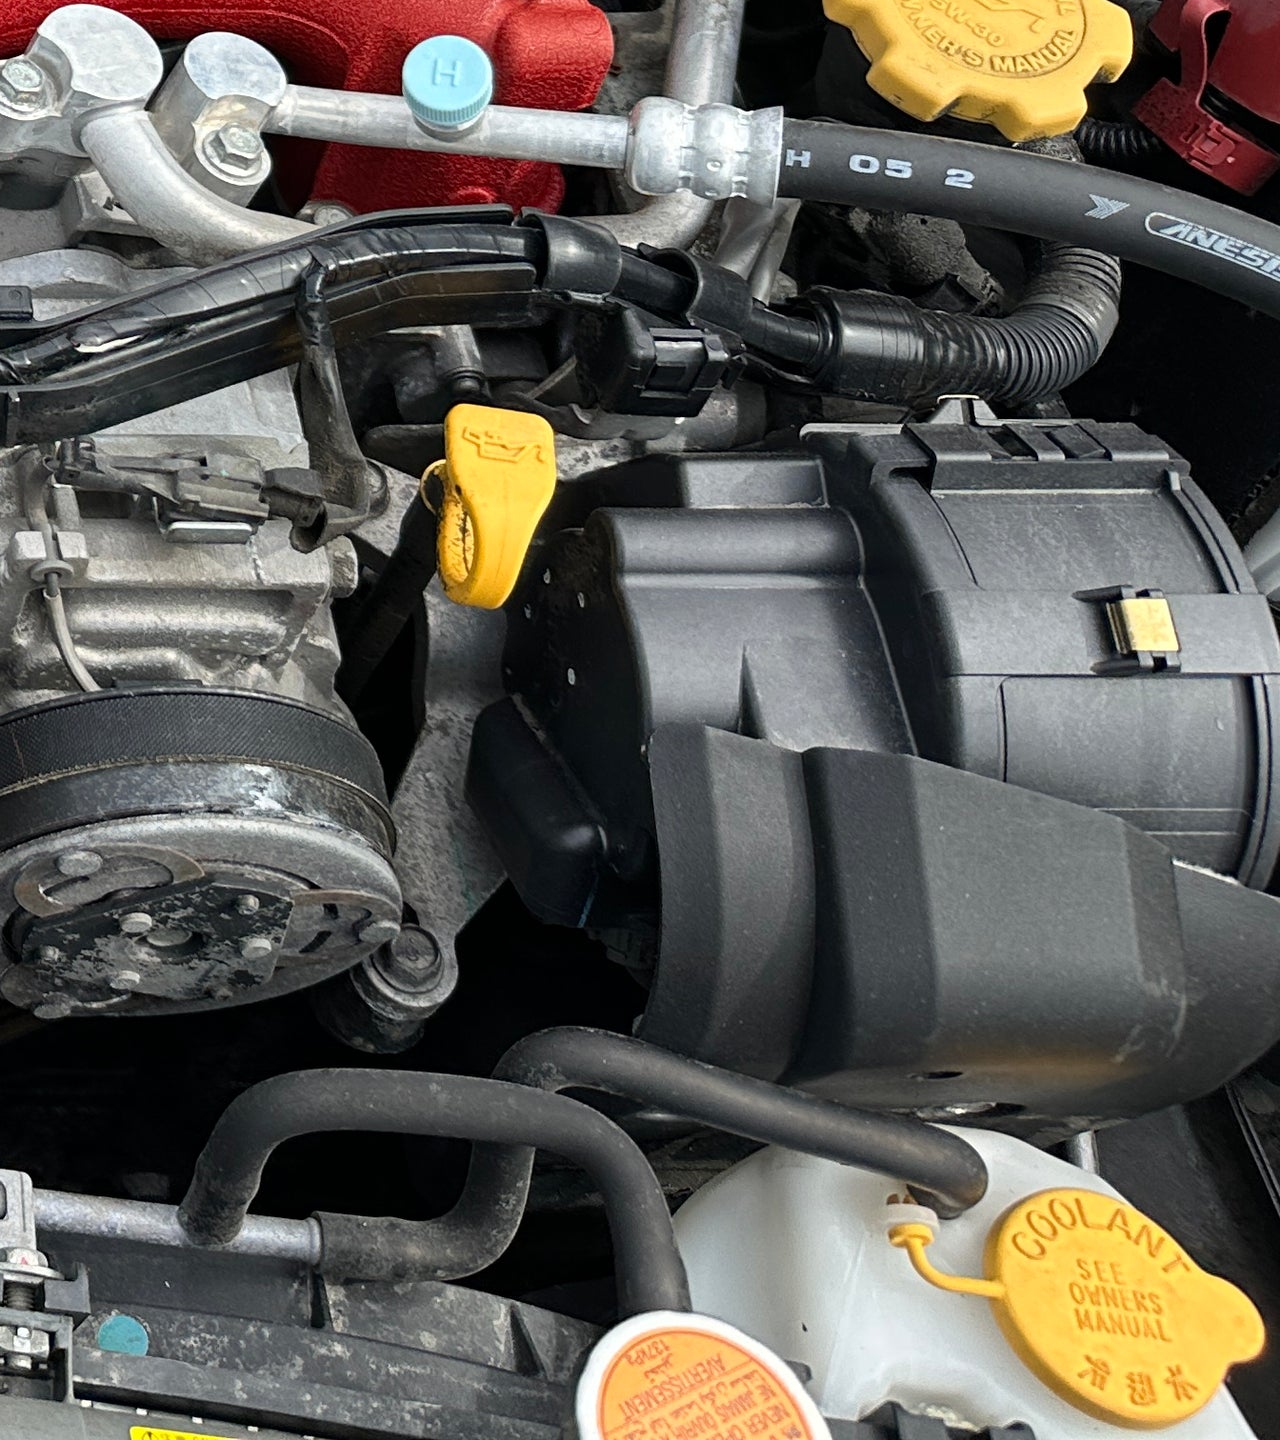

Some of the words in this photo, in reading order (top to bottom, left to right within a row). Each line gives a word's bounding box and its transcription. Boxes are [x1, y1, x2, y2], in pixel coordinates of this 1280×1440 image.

[989, 28, 1079, 74] MANUAL
[431, 57, 463, 88] H
[848, 153, 913, 180] 05
[943, 167, 976, 190] 2
[1011, 1197, 1192, 1274] COOLANT
[1075, 1258, 1127, 1286] SEE
[1074, 1307, 1173, 1343] MANUAL
[624, 1339, 671, 1368] 137kPa
[618, 1352, 727, 1421] AVERTISSEMENT
[714, 1390, 758, 1424] JAMAIS
[743, 1402, 792, 1436] NEVER
